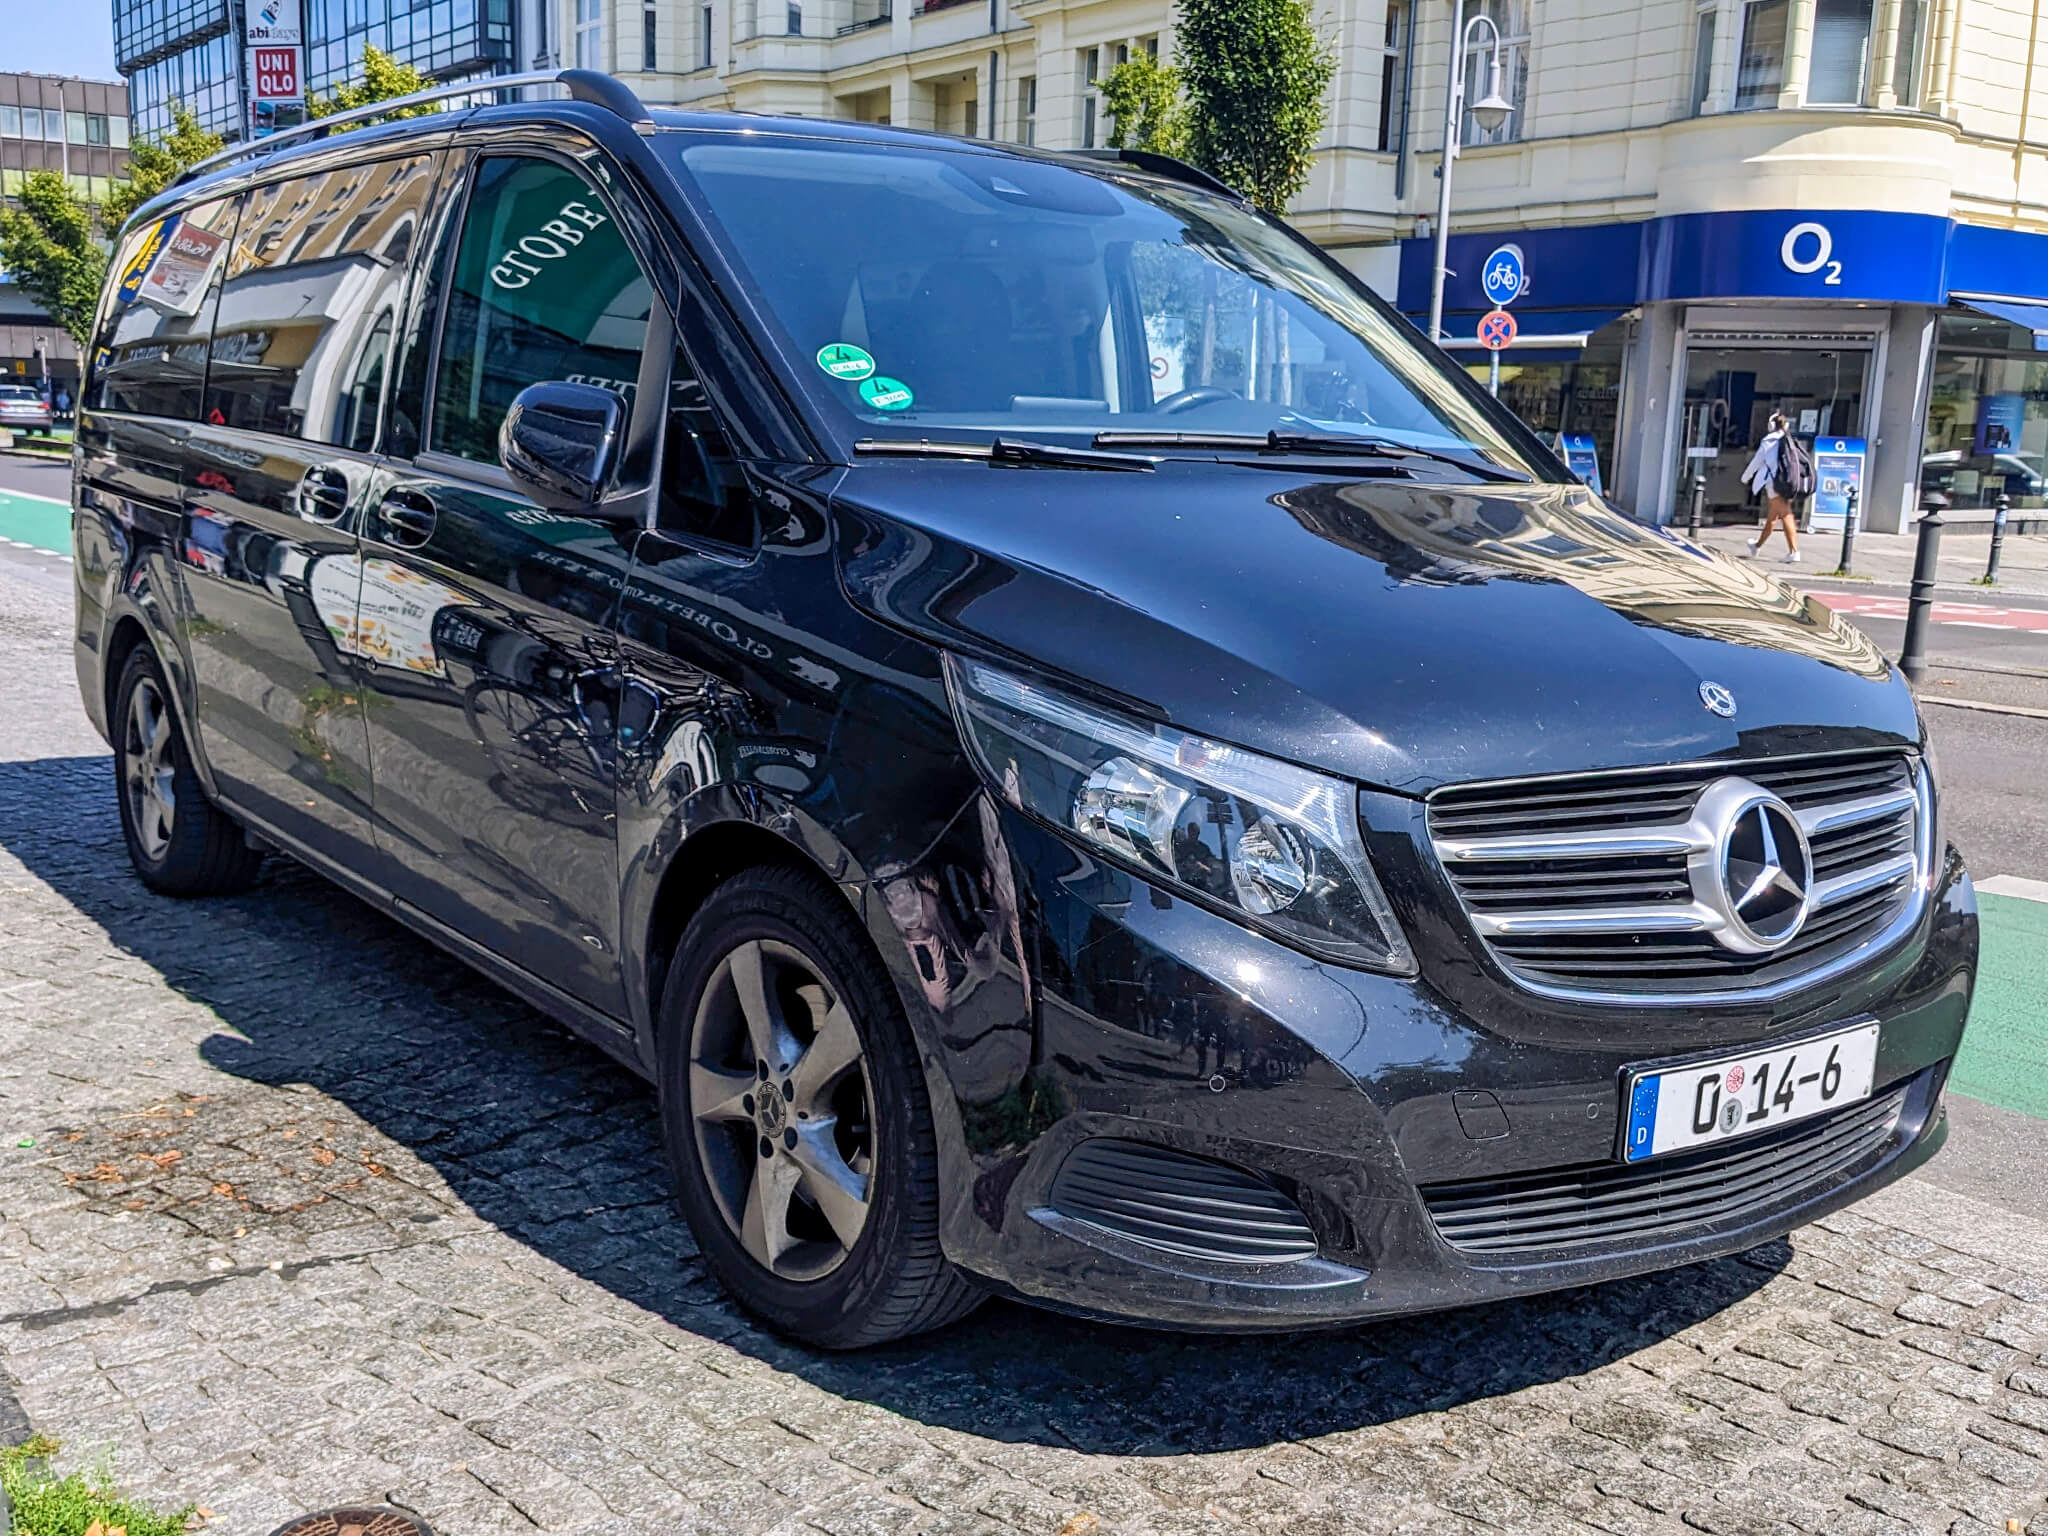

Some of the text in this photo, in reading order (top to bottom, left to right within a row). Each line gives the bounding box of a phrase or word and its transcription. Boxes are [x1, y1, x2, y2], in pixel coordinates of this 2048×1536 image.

[249, 26, 269, 39] abi
[259, 54, 290, 72] UNI
[260, 74, 294, 95] QLO
[1781, 222, 1842, 285] O2
[835, 346, 850, 361] 4
[873, 379, 890, 393] 4
[1746, 1044, 1841, 1124] 14-6
[1636, 1127, 1647, 1144] D
